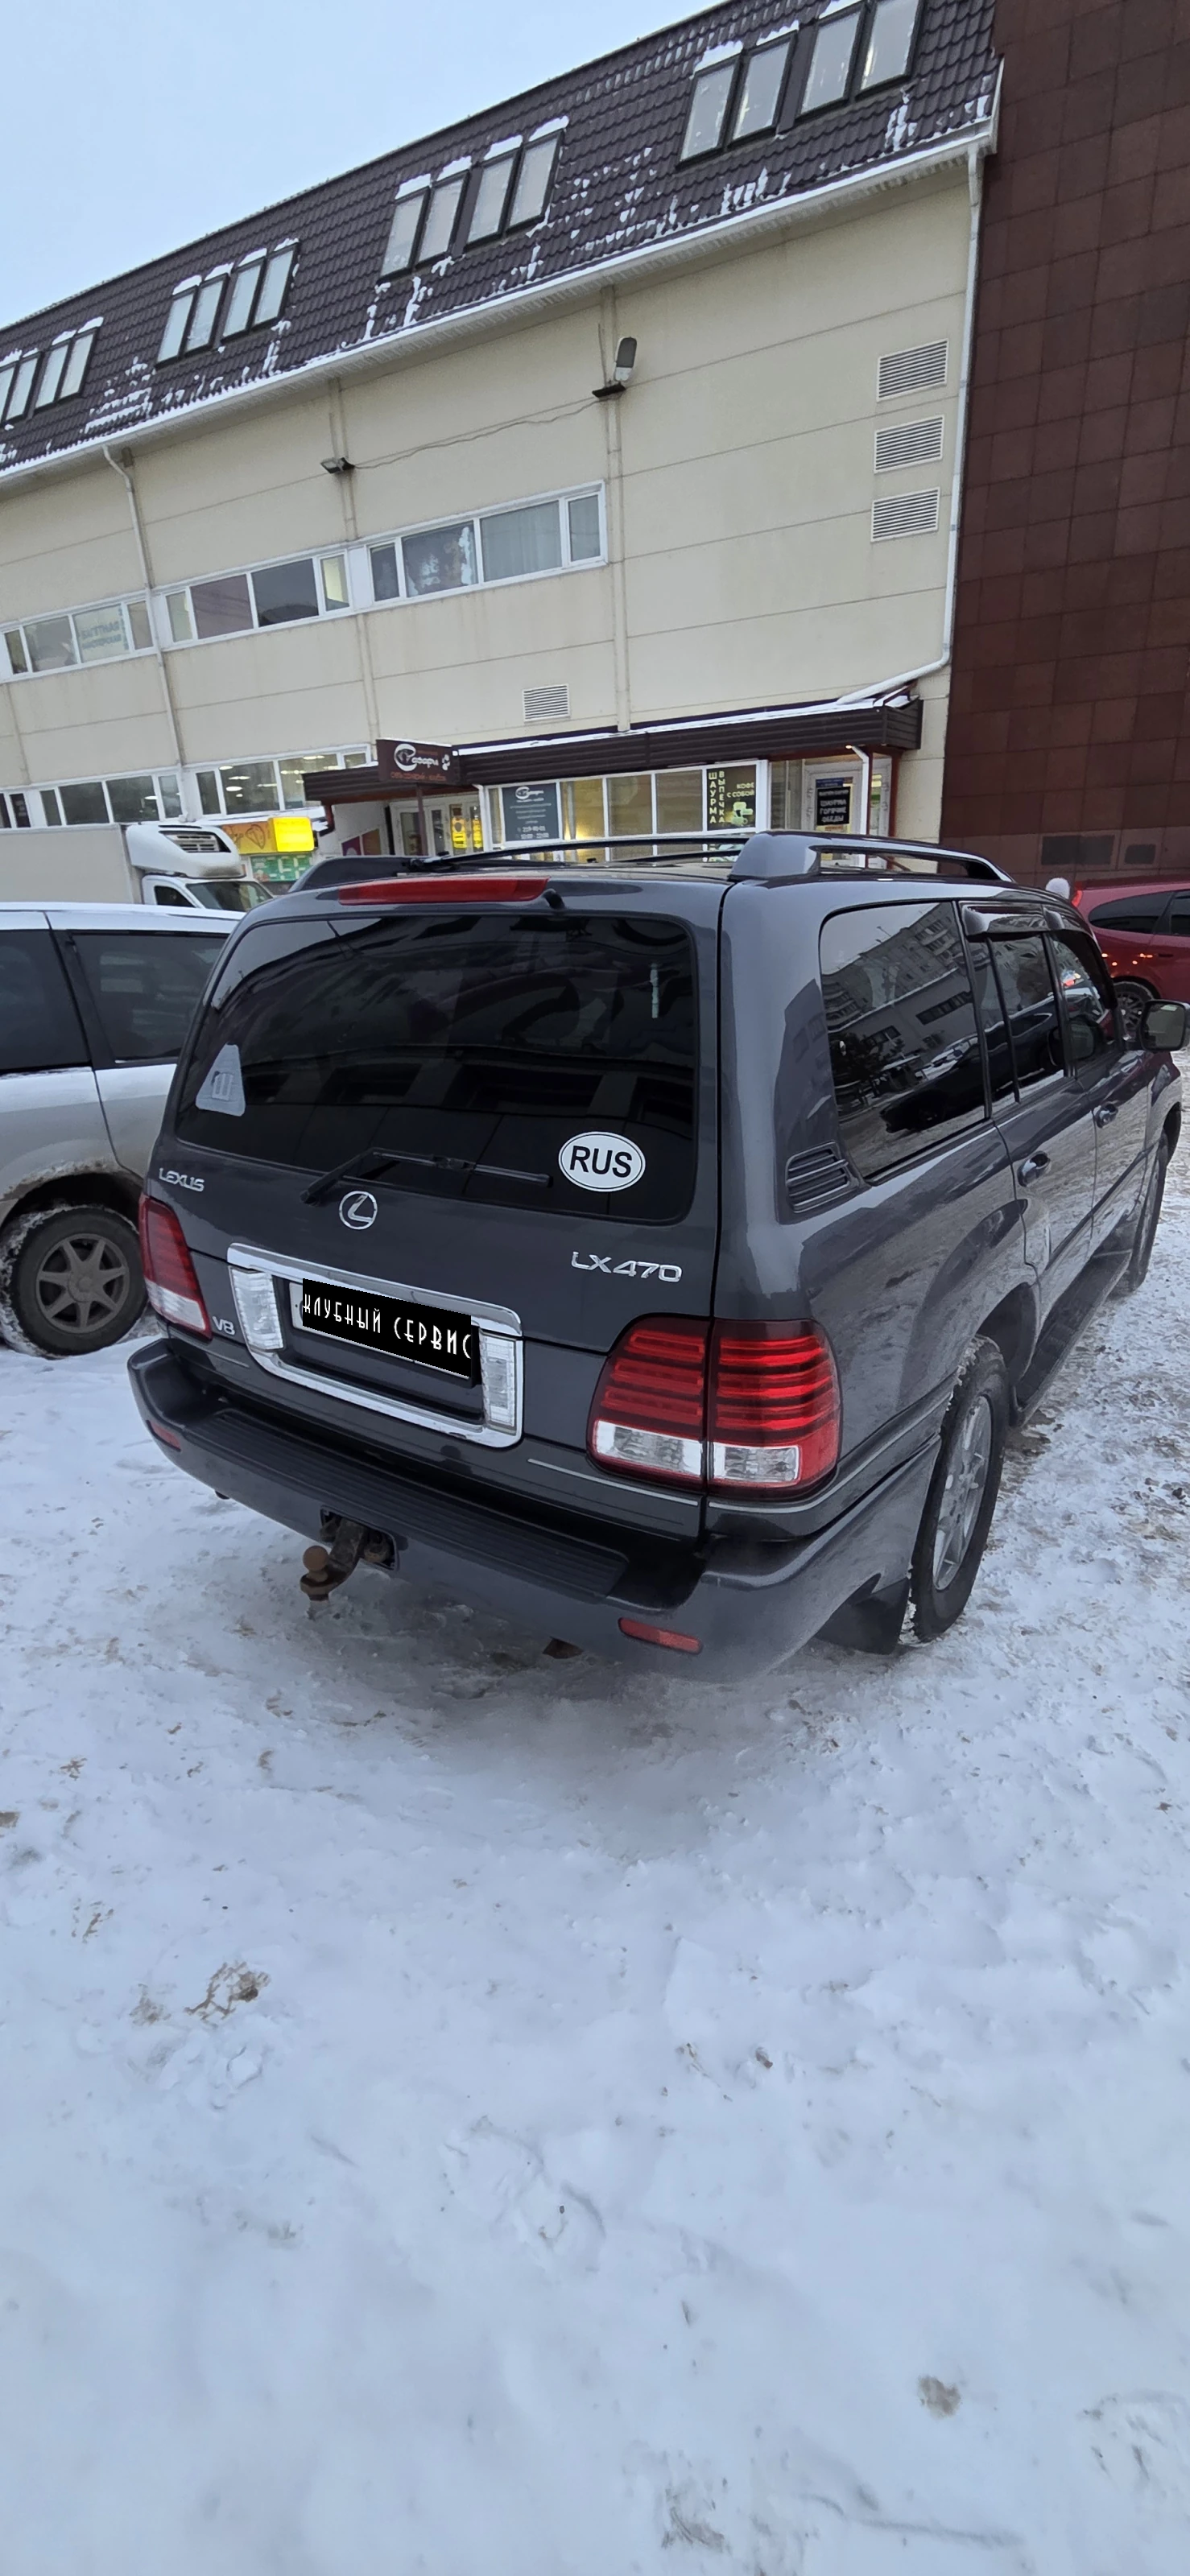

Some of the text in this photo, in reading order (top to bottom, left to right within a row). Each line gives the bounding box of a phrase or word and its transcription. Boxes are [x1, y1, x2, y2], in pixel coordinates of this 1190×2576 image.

[709, 772, 717, 824] ШАУРМА
[732, 790, 754, 798] СОБОЙ
[569, 1145, 633, 1178] RUS
[159, 1167, 205, 1192] LEXUS
[212, 1315, 235, 1336] V8
